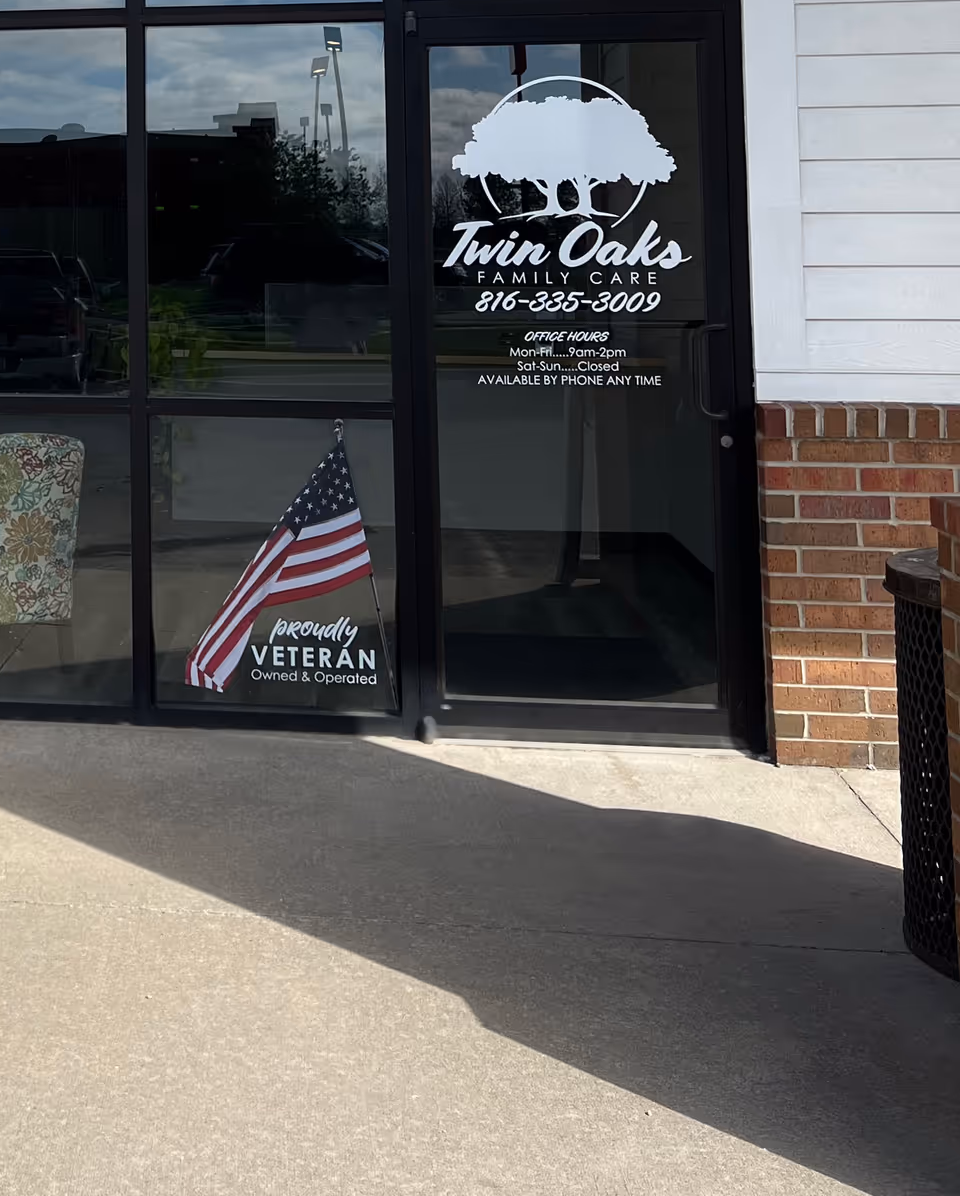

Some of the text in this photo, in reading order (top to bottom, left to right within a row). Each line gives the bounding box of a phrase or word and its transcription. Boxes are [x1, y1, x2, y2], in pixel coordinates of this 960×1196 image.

[442, 219, 692, 270] Twin Oaks
[477, 270, 658, 285] FAMILY CARE
[474, 290, 661, 313] 816-335-3009
[524, 331, 610, 342] OFFICE HOURS
[477, 374, 662, 386] AVAILABLE BY PHONE ANY TIME
[251, 645, 376, 670] VETERAN
[250, 668, 377, 685] Owned & Operated
